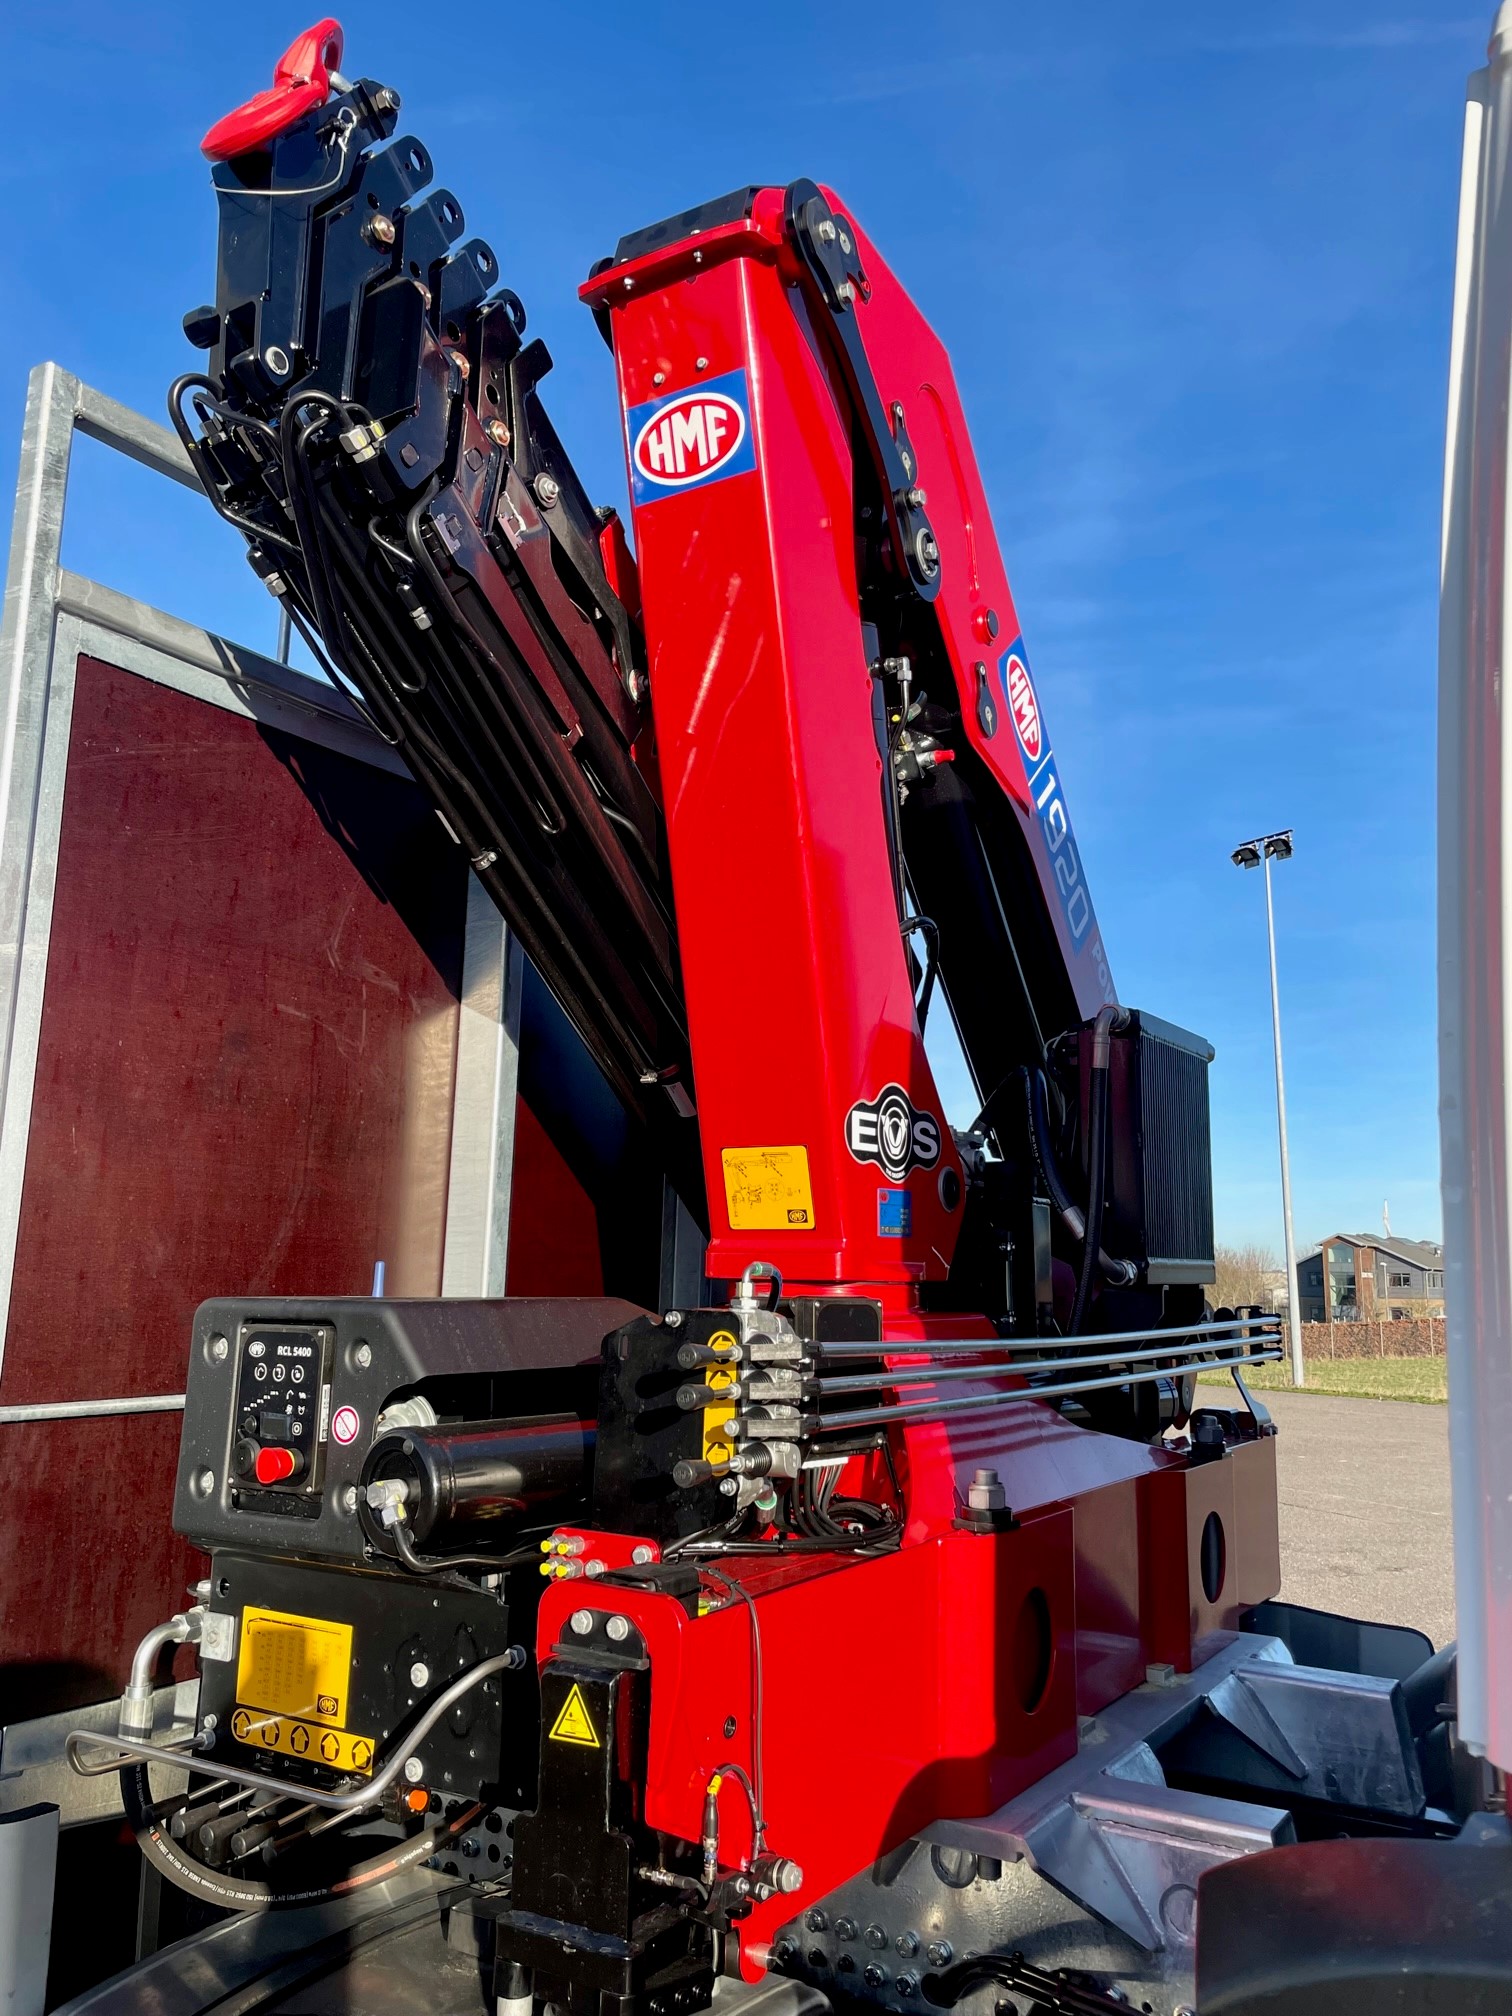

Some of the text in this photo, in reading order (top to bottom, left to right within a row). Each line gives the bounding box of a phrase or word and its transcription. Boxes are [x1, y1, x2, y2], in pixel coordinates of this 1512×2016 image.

[647, 405, 728, 474] HMF
[1010, 667, 1090, 939] HMF 1920
[277, 1345, 293, 1356] RCL
[292, 1346, 312, 1358] 5400
[321, 1698, 335, 1712] HMF
